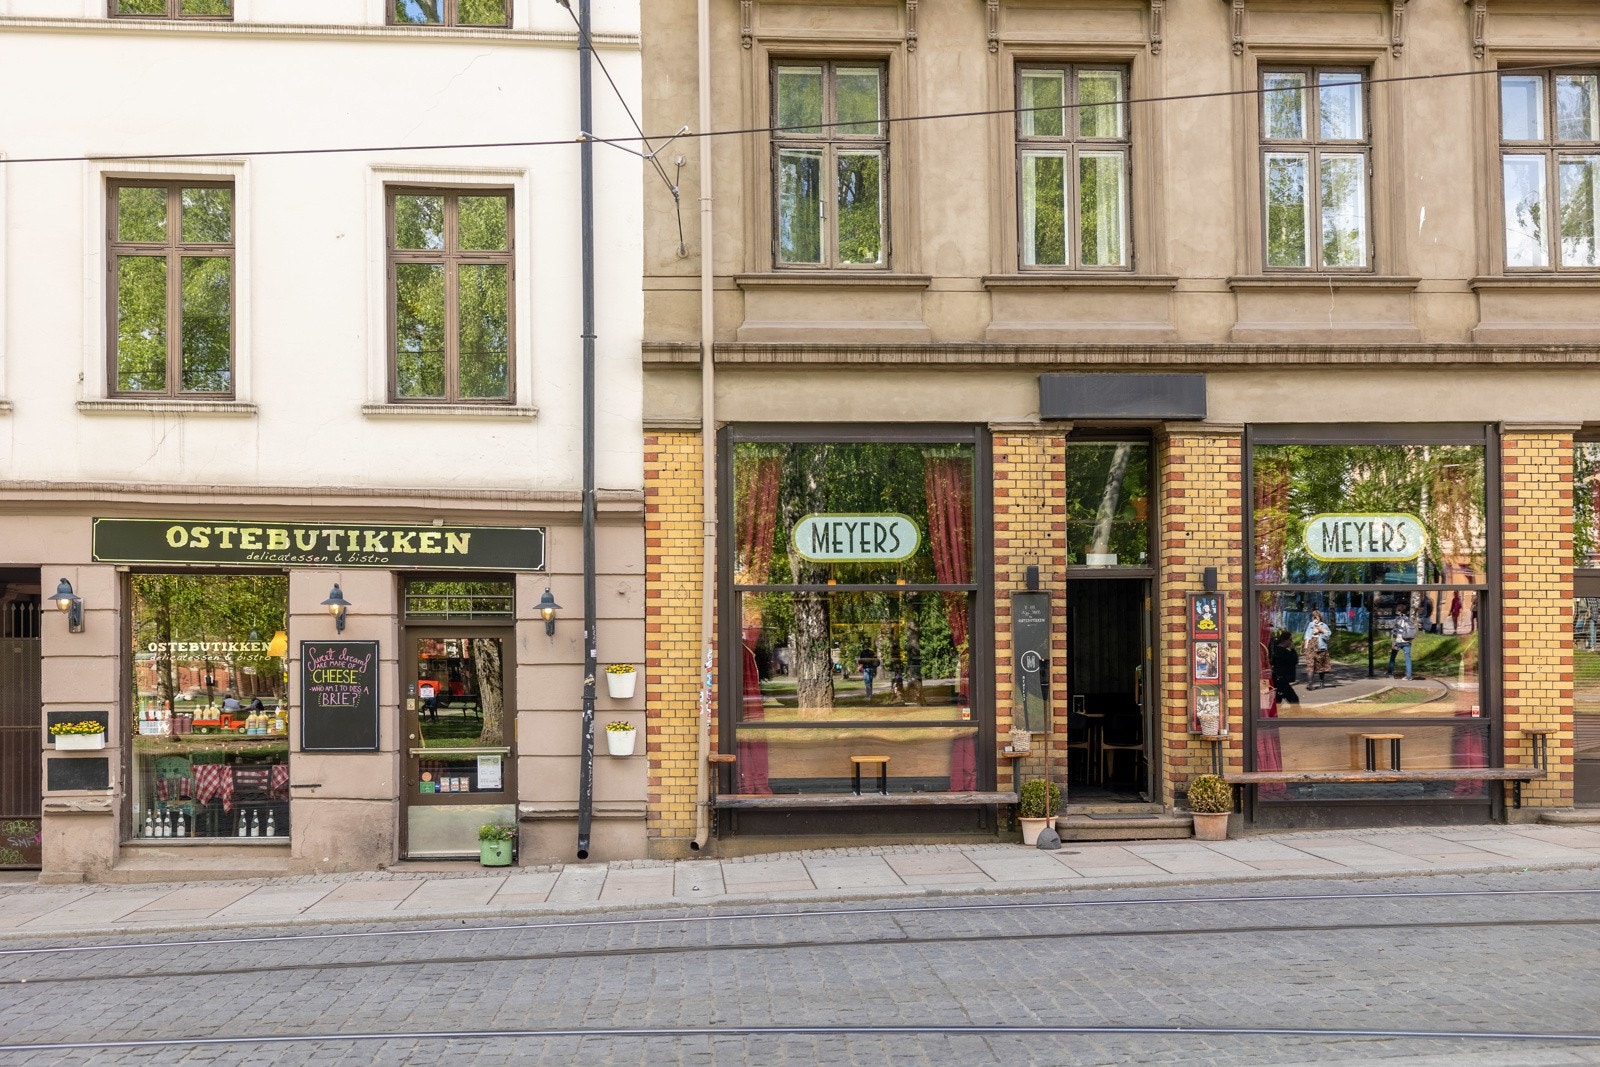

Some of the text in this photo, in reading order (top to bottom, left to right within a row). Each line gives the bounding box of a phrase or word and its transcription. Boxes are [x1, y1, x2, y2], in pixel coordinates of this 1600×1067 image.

[165, 525, 471, 555] OSTEBUTIKKEN
[812, 521, 900, 553] MEYERS
[1321, 521, 1407, 552] MEYERS
[246, 551, 389, 563] delicatessen & bistro
[149, 652, 272, 661] delicatessen & bistro
[308, 647, 335, 671] Sweet
[330, 660, 346, 668] MADE
[312, 669, 358, 684] CHEESE
[363, 686, 369, 695] A
[322, 692, 358, 705] BRIE?
